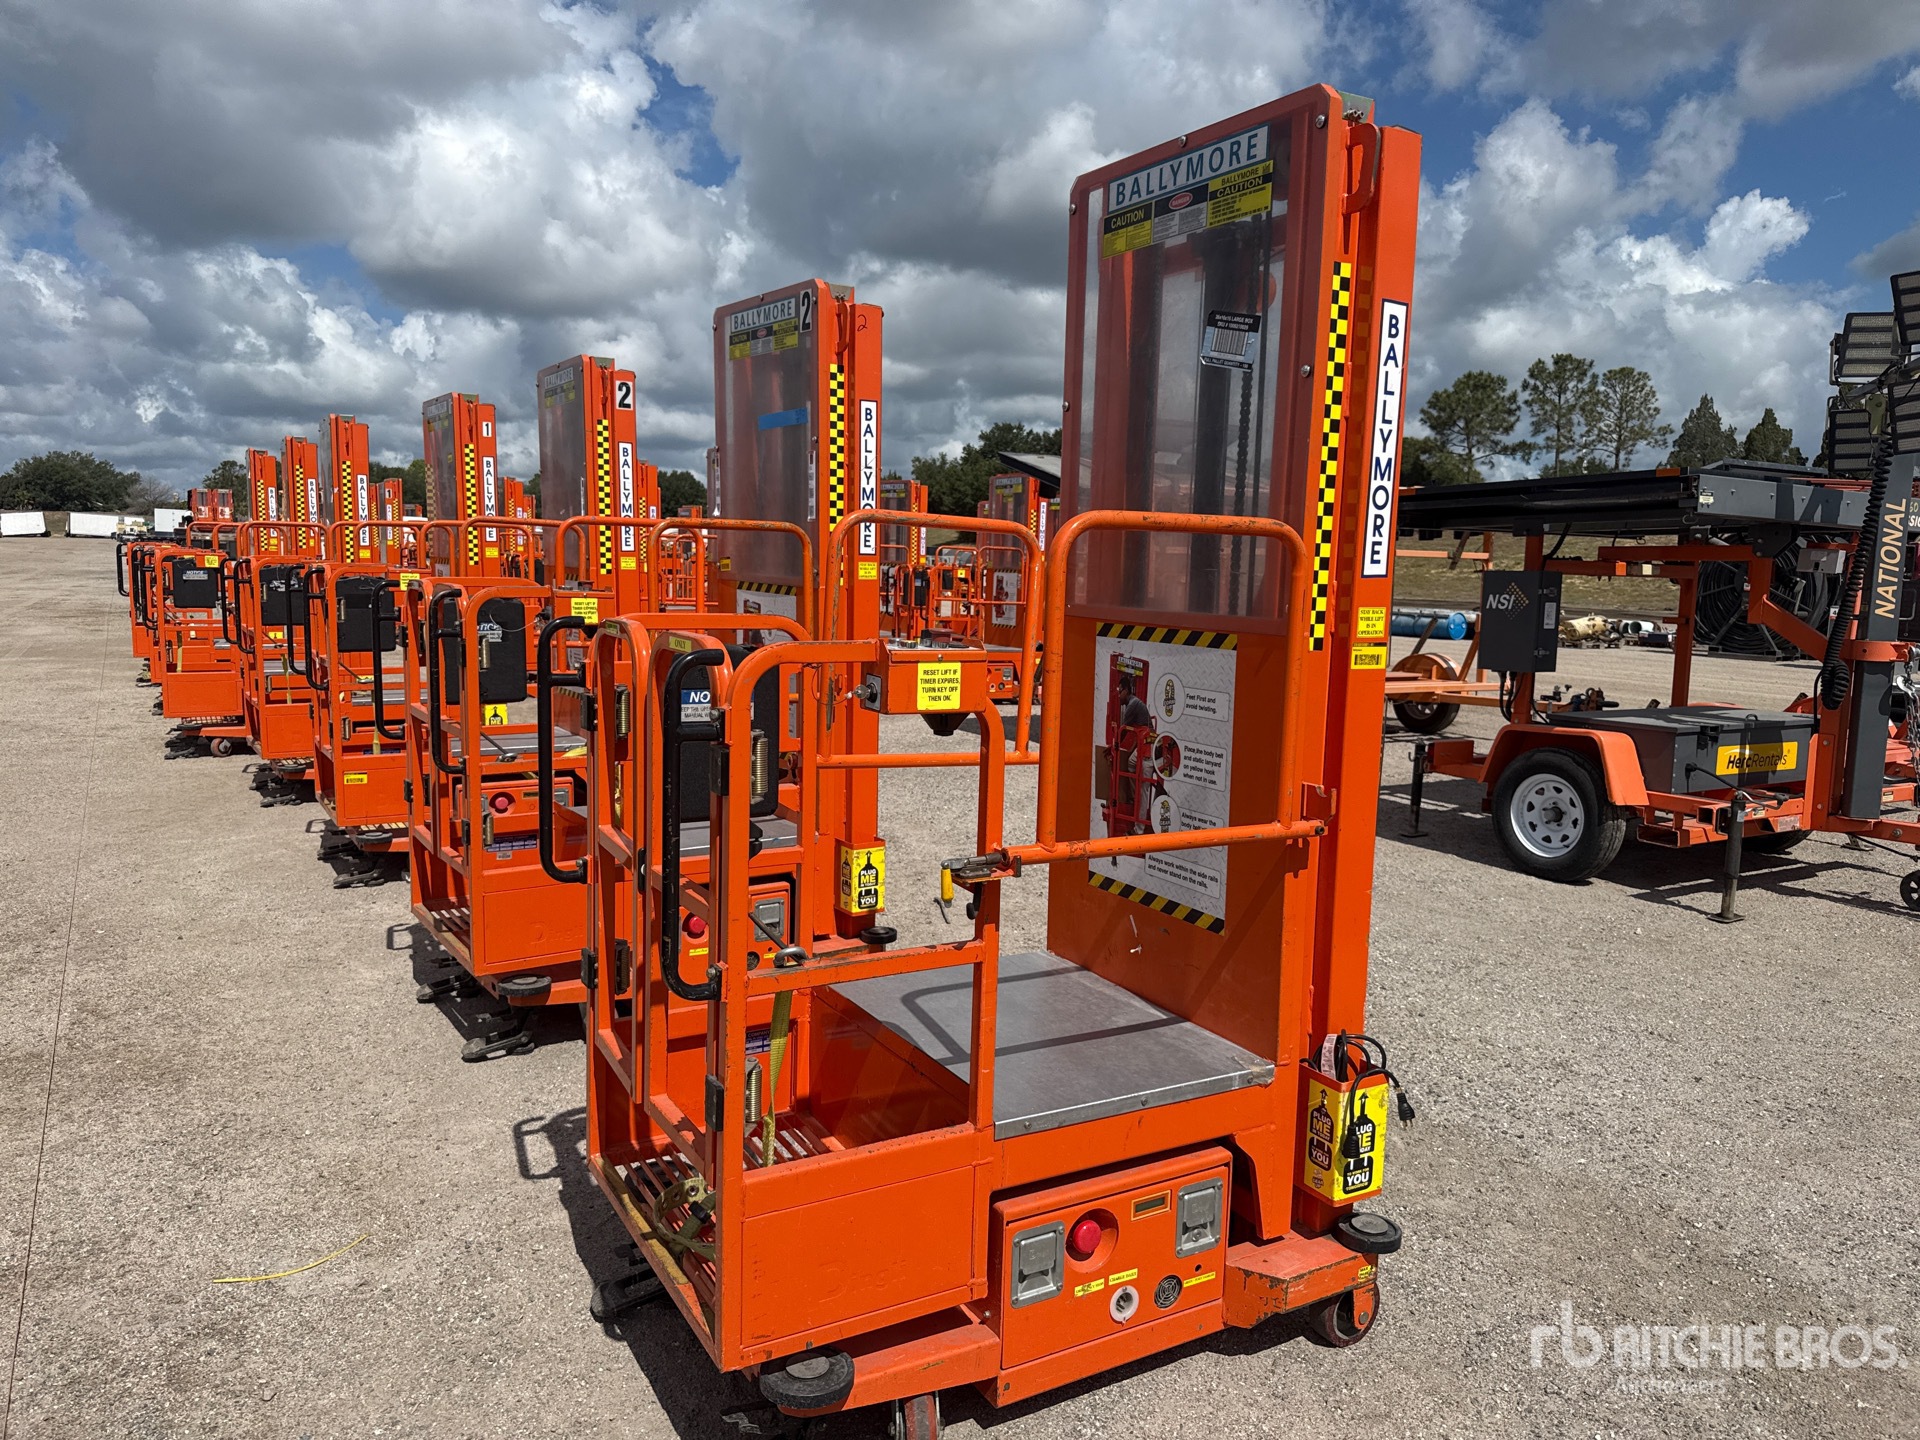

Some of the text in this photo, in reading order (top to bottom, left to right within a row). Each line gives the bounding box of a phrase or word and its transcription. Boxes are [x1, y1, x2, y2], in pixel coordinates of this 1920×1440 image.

[1116, 133, 1259, 207] BALLYMORE
[1221, 167, 1260, 185] BALLYMORE
[1217, 176, 1263, 198] CAUTION
[1111, 208, 1145, 229] CAUTION
[734, 300, 792, 330] BALLYMORE
[801, 291, 811, 331] 2
[857, 314, 867, 332] 2
[617, 381, 632, 409] 2
[484, 423, 490, 436] 1
[1370, 314, 1399, 565] BALLYMORE
[486, 460, 495, 539] BALLYME
[622, 447, 632, 547] BALLYMRE
[360, 478, 368, 543] BALLYMRE
[1874, 498, 1906, 619] NATIONAL
[1486, 594, 1516, 609] NSI
[675, 638, 686, 649] ONLY
[1186, 693, 1196, 701] Feet
[1196, 695, 1206, 703] First
[1198, 705, 1217, 714] twisting.
[1184, 745, 1195, 754] Place
[1203, 749, 1214, 758] body
[1215, 751, 1224, 759] belt
[1190, 764, 1203, 773] yellow
[1204, 767, 1215, 775] hook
[1205, 759, 1221, 768] lanyard
[1726, 753, 1788, 770] HercRentals
[1182, 812, 1197, 821] Always
[1181, 821, 1192, 830] body
[860, 868, 877, 876] PLUG
[1148, 854, 1163, 864] Always
[1164, 860, 1175, 868] work
[1176, 863, 1188, 872] within
[1197, 871, 1207, 880] side
[1208, 874, 1218, 883] rails
[1148, 863, 1156, 871] and
[1157, 867, 1168, 875] never
[1169, 870, 1181, 879] stand
[1197, 879, 1208, 889] rails.
[860, 874, 876, 883] ME
[860, 896, 876, 905] YOU
[1313, 1110, 1332, 1126] PLUG
[1313, 1118, 1331, 1137] ME
[1356, 1123, 1373, 1135] LUG
[1311, 1148, 1329, 1165] YOU
[1346, 1172, 1370, 1186] YOU
